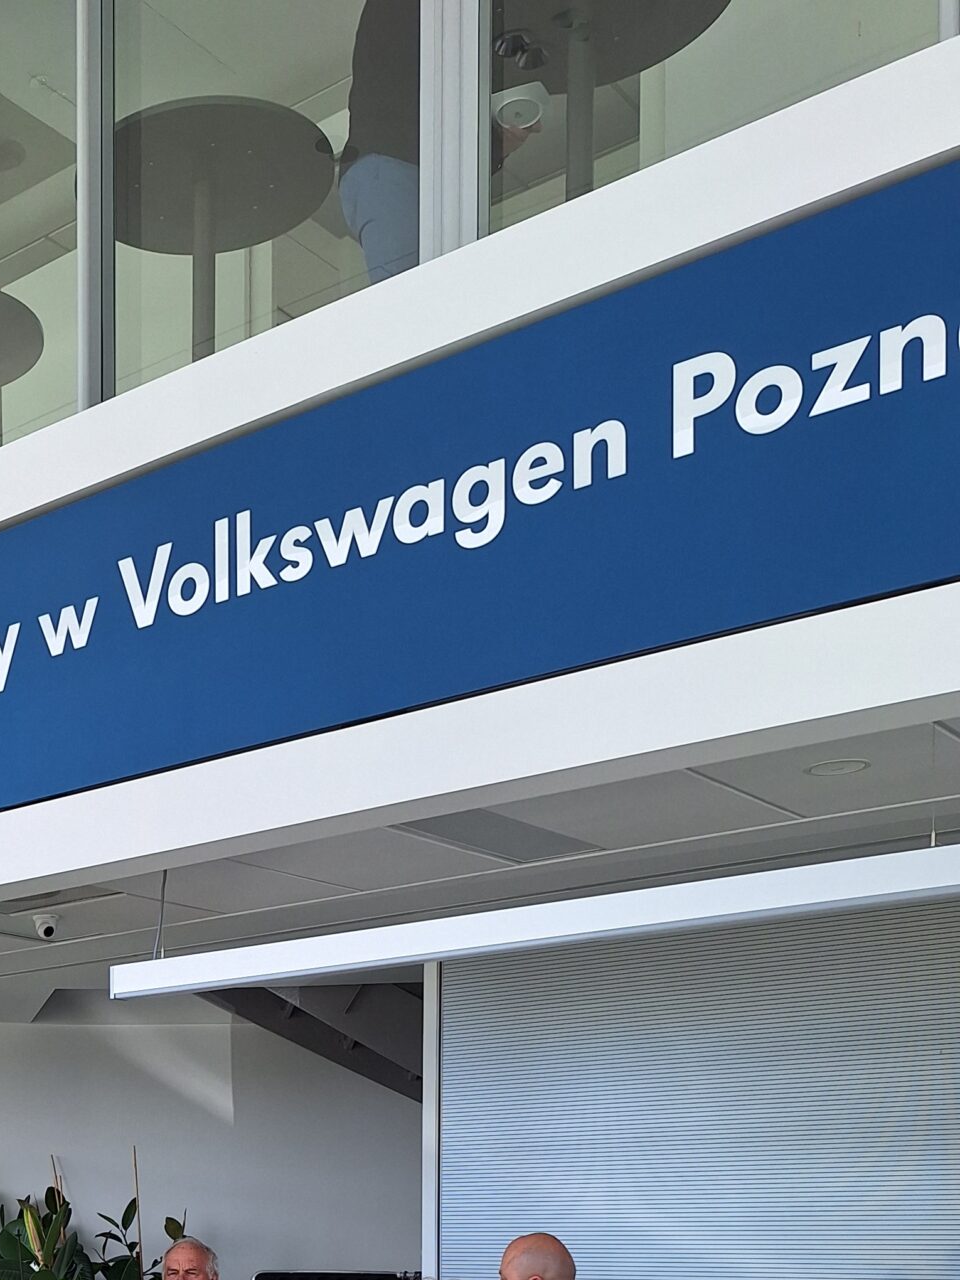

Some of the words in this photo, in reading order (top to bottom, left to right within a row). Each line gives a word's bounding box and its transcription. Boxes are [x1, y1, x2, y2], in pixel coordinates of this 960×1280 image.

[38, 596, 99, 657] w
[118, 419, 627, 629] Volkswagen
[674, 314, 960, 459] Pozn
